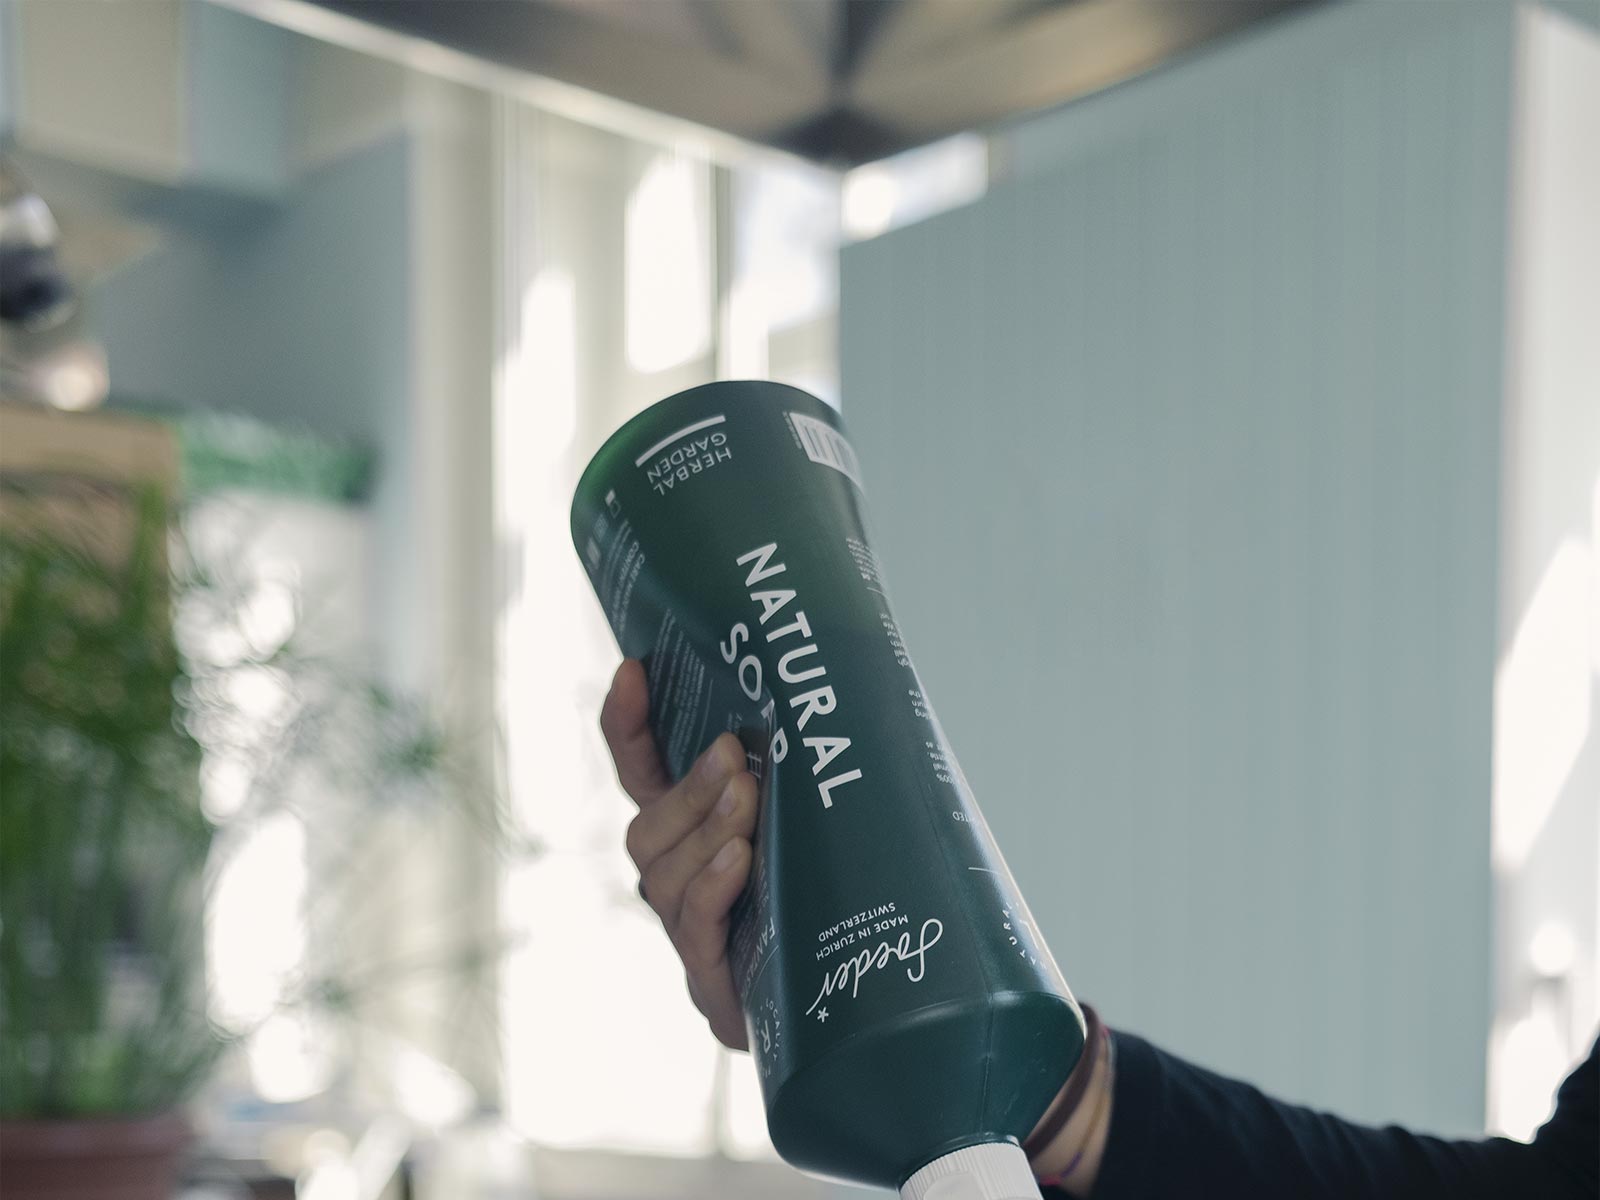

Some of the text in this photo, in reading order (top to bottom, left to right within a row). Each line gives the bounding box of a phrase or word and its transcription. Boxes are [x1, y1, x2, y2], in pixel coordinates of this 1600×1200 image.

[647, 432, 727, 484] GARDEN
[653, 446, 733, 496] HERBAL
[736, 542, 863, 809] NATURAL
[816, 914, 908, 960] MADE IN ZURICH
[818, 902, 896, 941] SWITZERLAND
